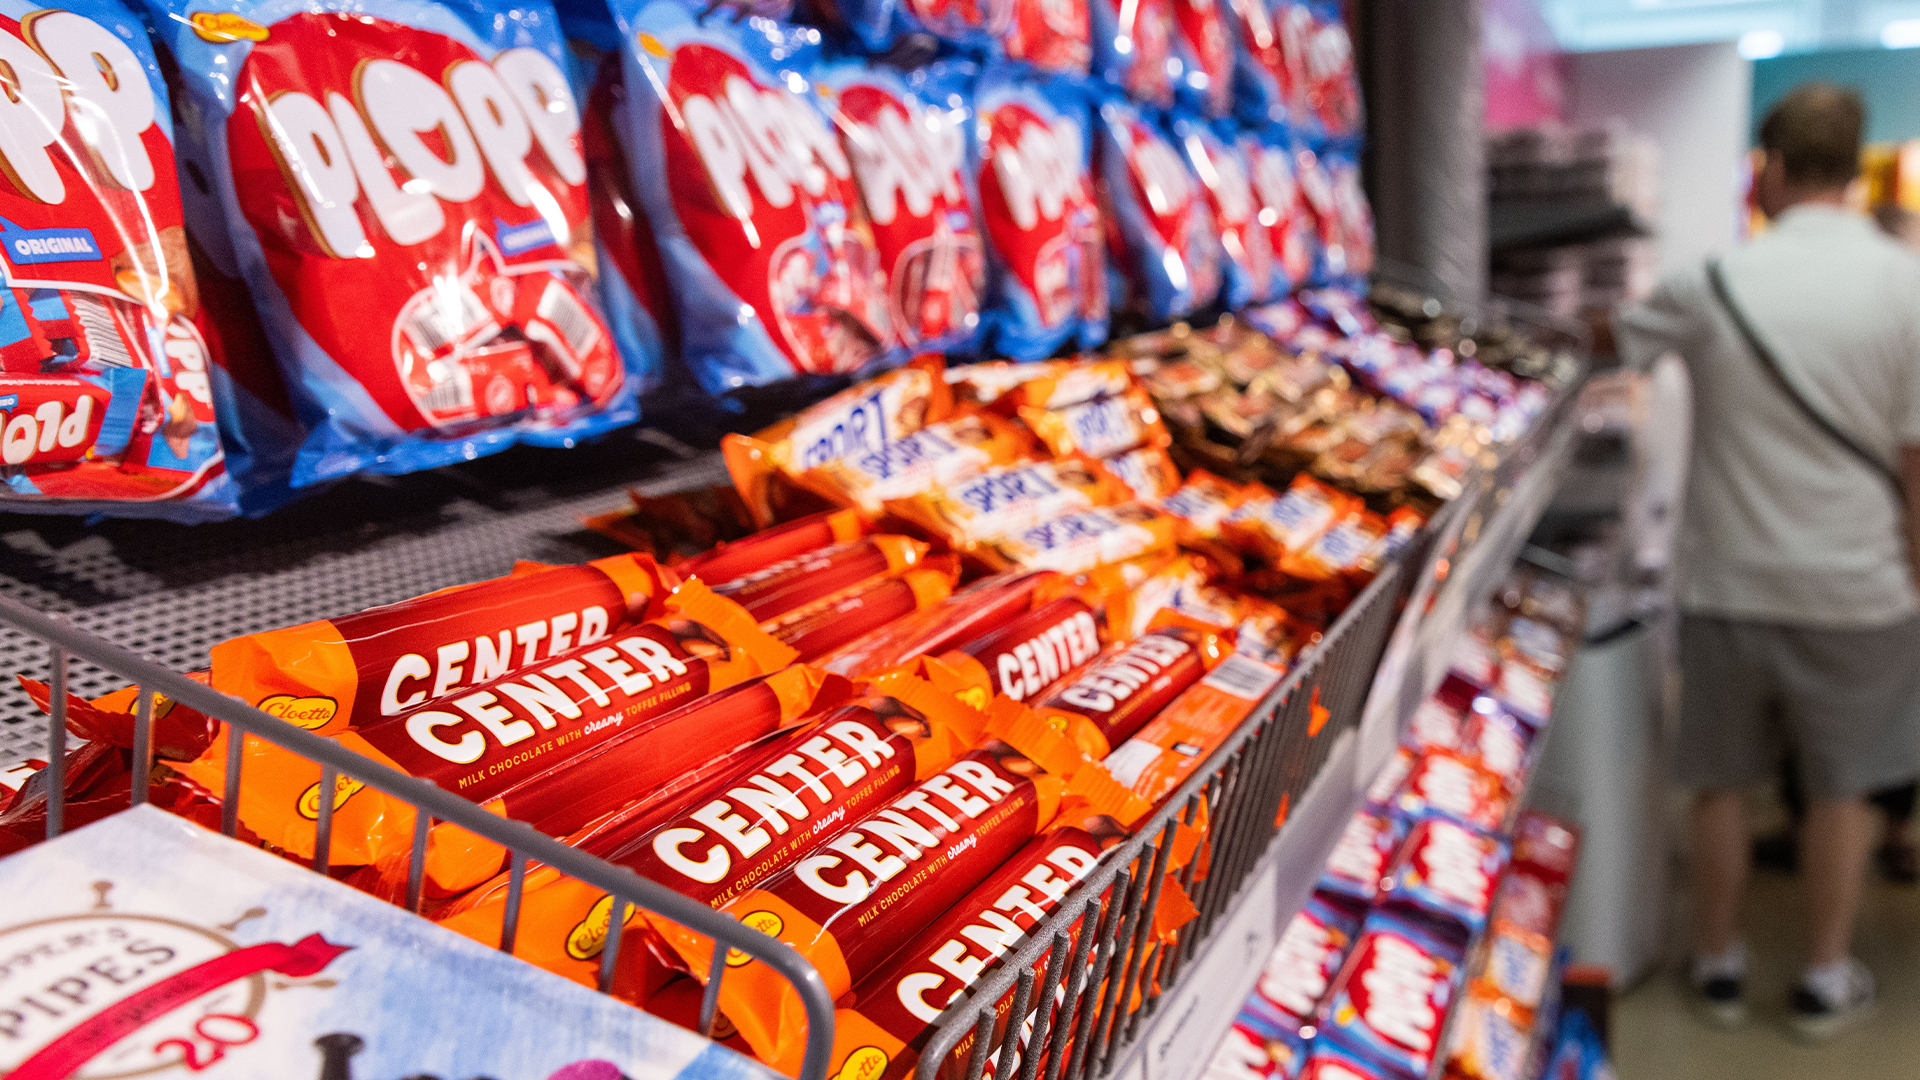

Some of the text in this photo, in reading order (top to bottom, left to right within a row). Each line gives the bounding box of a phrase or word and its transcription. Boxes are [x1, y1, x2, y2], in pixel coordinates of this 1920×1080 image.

[258, 48, 587, 259] PLOPP
[15, 237, 94, 256] ORIGINAL
[405, 636, 688, 764] CENTER
[997, 611, 1100, 701] CENTER
[1061, 634, 1191, 712] CENTER
[458, 681, 692, 790] MILK CHOCOLATE WITH creamy TOFFEE FILLING
[652, 720, 896, 884] CENTER
[710, 764, 901, 909] MILK CHOCOLATE WITH creamy TOFFEE FILLING
[795, 760, 1015, 905] CENTER
[857, 796, 1025, 928] MILK CHOCOLATE WITH creamy TOFFEE FILLING
[153, 1013, 260, 1071] 20
